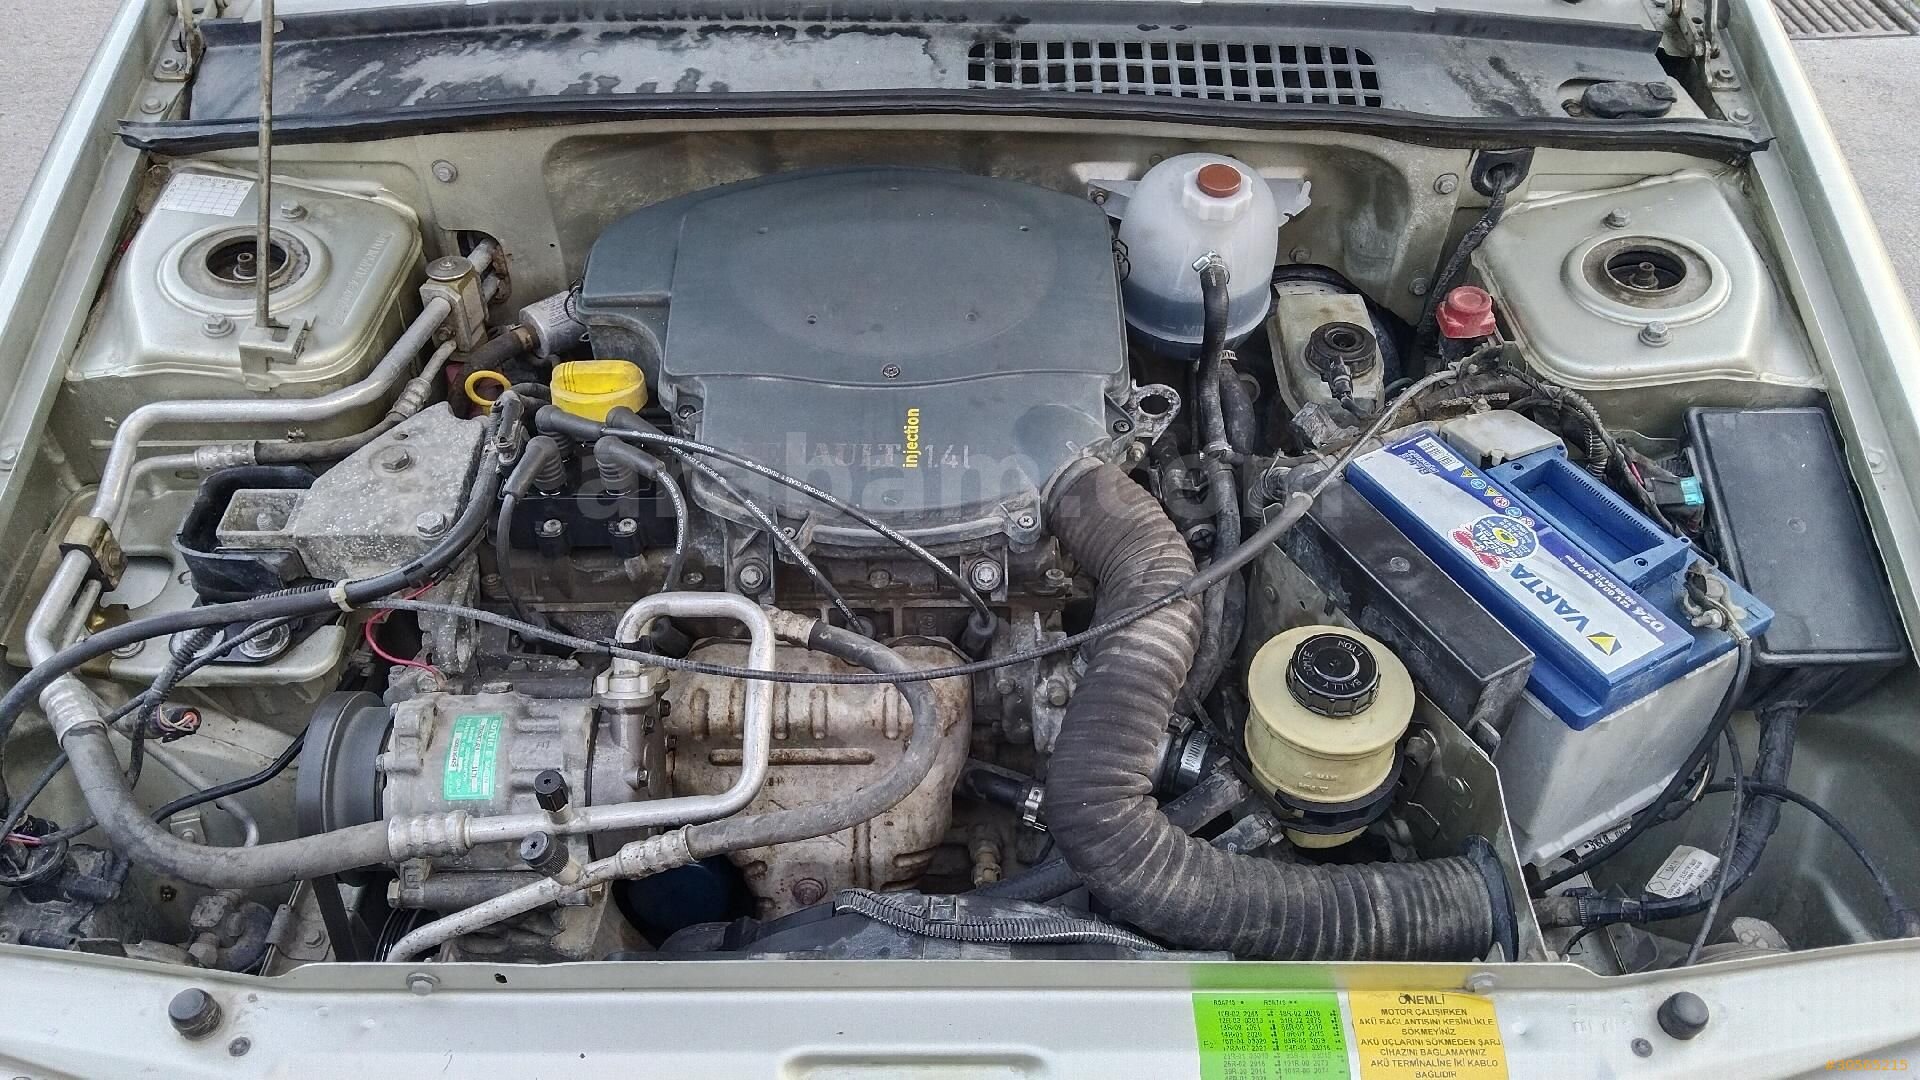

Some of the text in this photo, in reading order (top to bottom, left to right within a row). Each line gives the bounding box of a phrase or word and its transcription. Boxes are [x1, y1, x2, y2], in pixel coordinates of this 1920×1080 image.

[903, 408, 921, 469] injection
[745, 499, 772, 526] BOUGICORD
[1510, 562, 1590, 633] VARTA
[1632, 606, 1667, 633] D24
[1337, 640, 1364, 657] LYON
[1381, 1008, 1468, 1017] MOTOR ÇALIŞIRKEN
[1361, 1038, 1501, 1047] AKÜ UÇLARINI SÖKMEDEN ŞARJ
[1380, 1048, 1486, 1056] CİHAZINI BAĞLAMAYINIZ
[1371, 1059, 1389, 1067] AKÜ
[1392, 1058, 1452, 1067] TERMİNALİNE
[1467, 1059, 1499, 1067] KABLO
